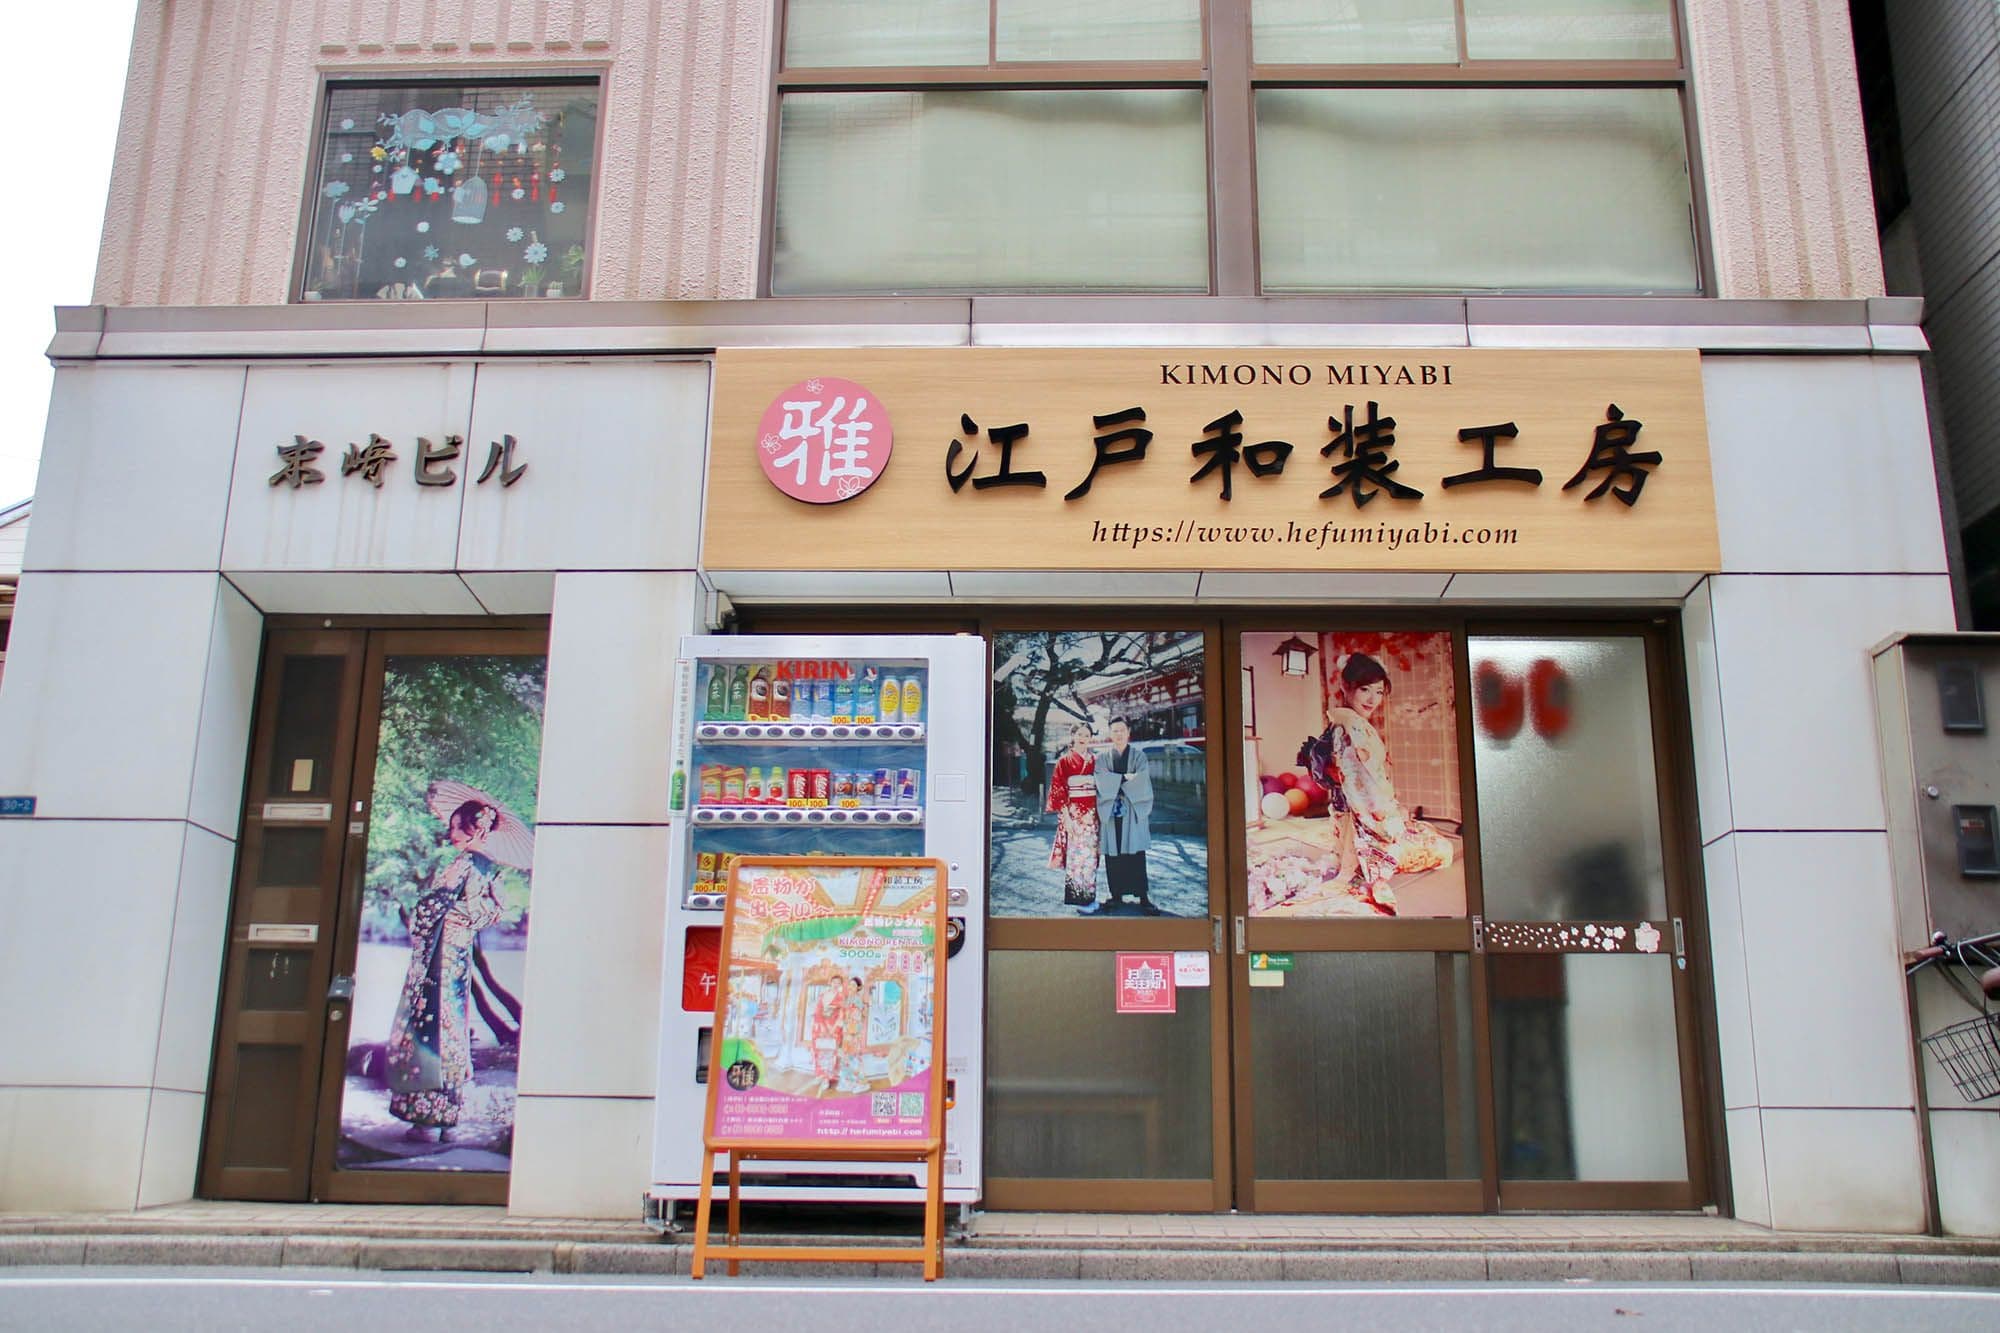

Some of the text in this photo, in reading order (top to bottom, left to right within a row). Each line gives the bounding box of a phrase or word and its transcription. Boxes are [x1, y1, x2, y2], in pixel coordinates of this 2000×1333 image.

[1160, 365, 1453, 385] KIMONO MIYABI
[773, 396, 873, 487] 雅
[945, 401, 1663, 508] 江戸和装工房
[1091, 520, 1519, 550] https://www.hefumiyabi.com
[776, 661, 848, 680] KIRIN
